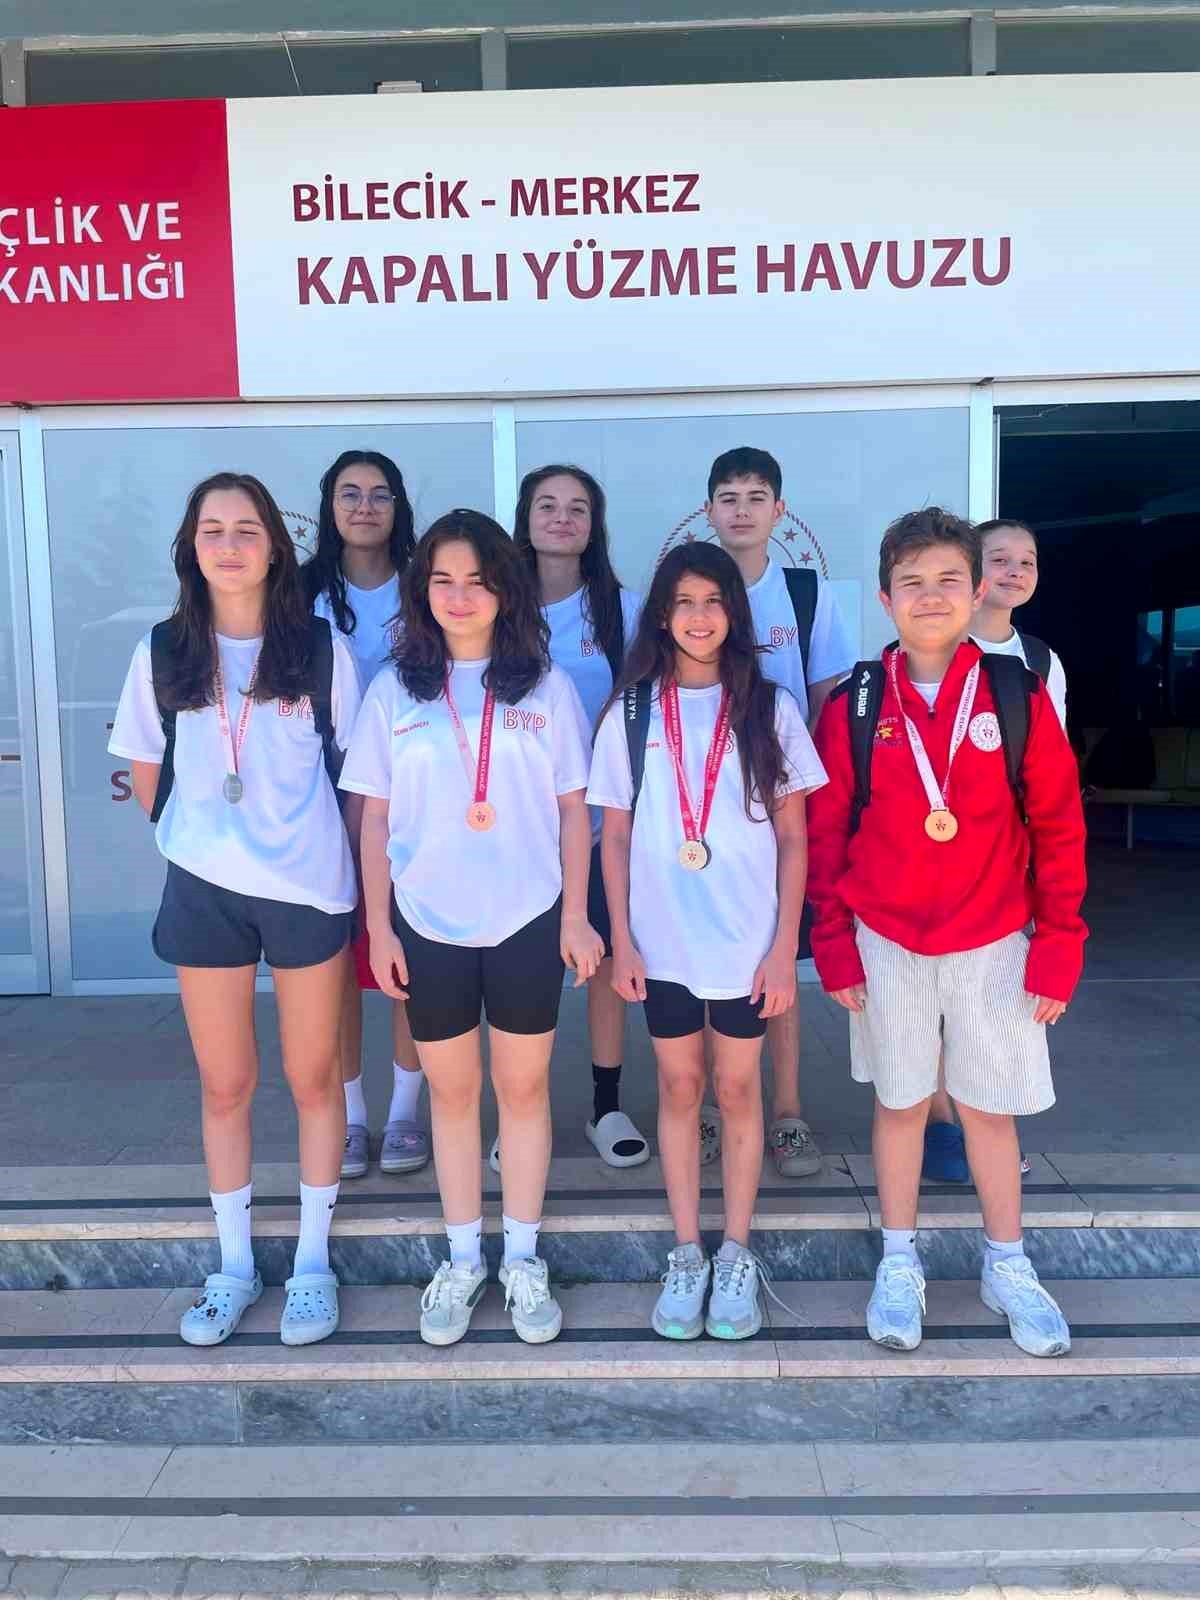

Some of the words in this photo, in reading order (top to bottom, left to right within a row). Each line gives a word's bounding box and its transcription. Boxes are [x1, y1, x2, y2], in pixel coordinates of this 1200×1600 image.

[293, 172, 470, 222] BİLECİK
[481, 199, 496, 207] -
[510, 174, 701, 216] MERKEZ
[118, 202, 182, 241] VE
[298, 254, 509, 304] KAPALI
[523, 239, 737, 299] YÜZME
[756, 237, 1012, 293] HAVUZU
[503, 708, 546, 735] BYP
[857, 687, 869, 717] arena
